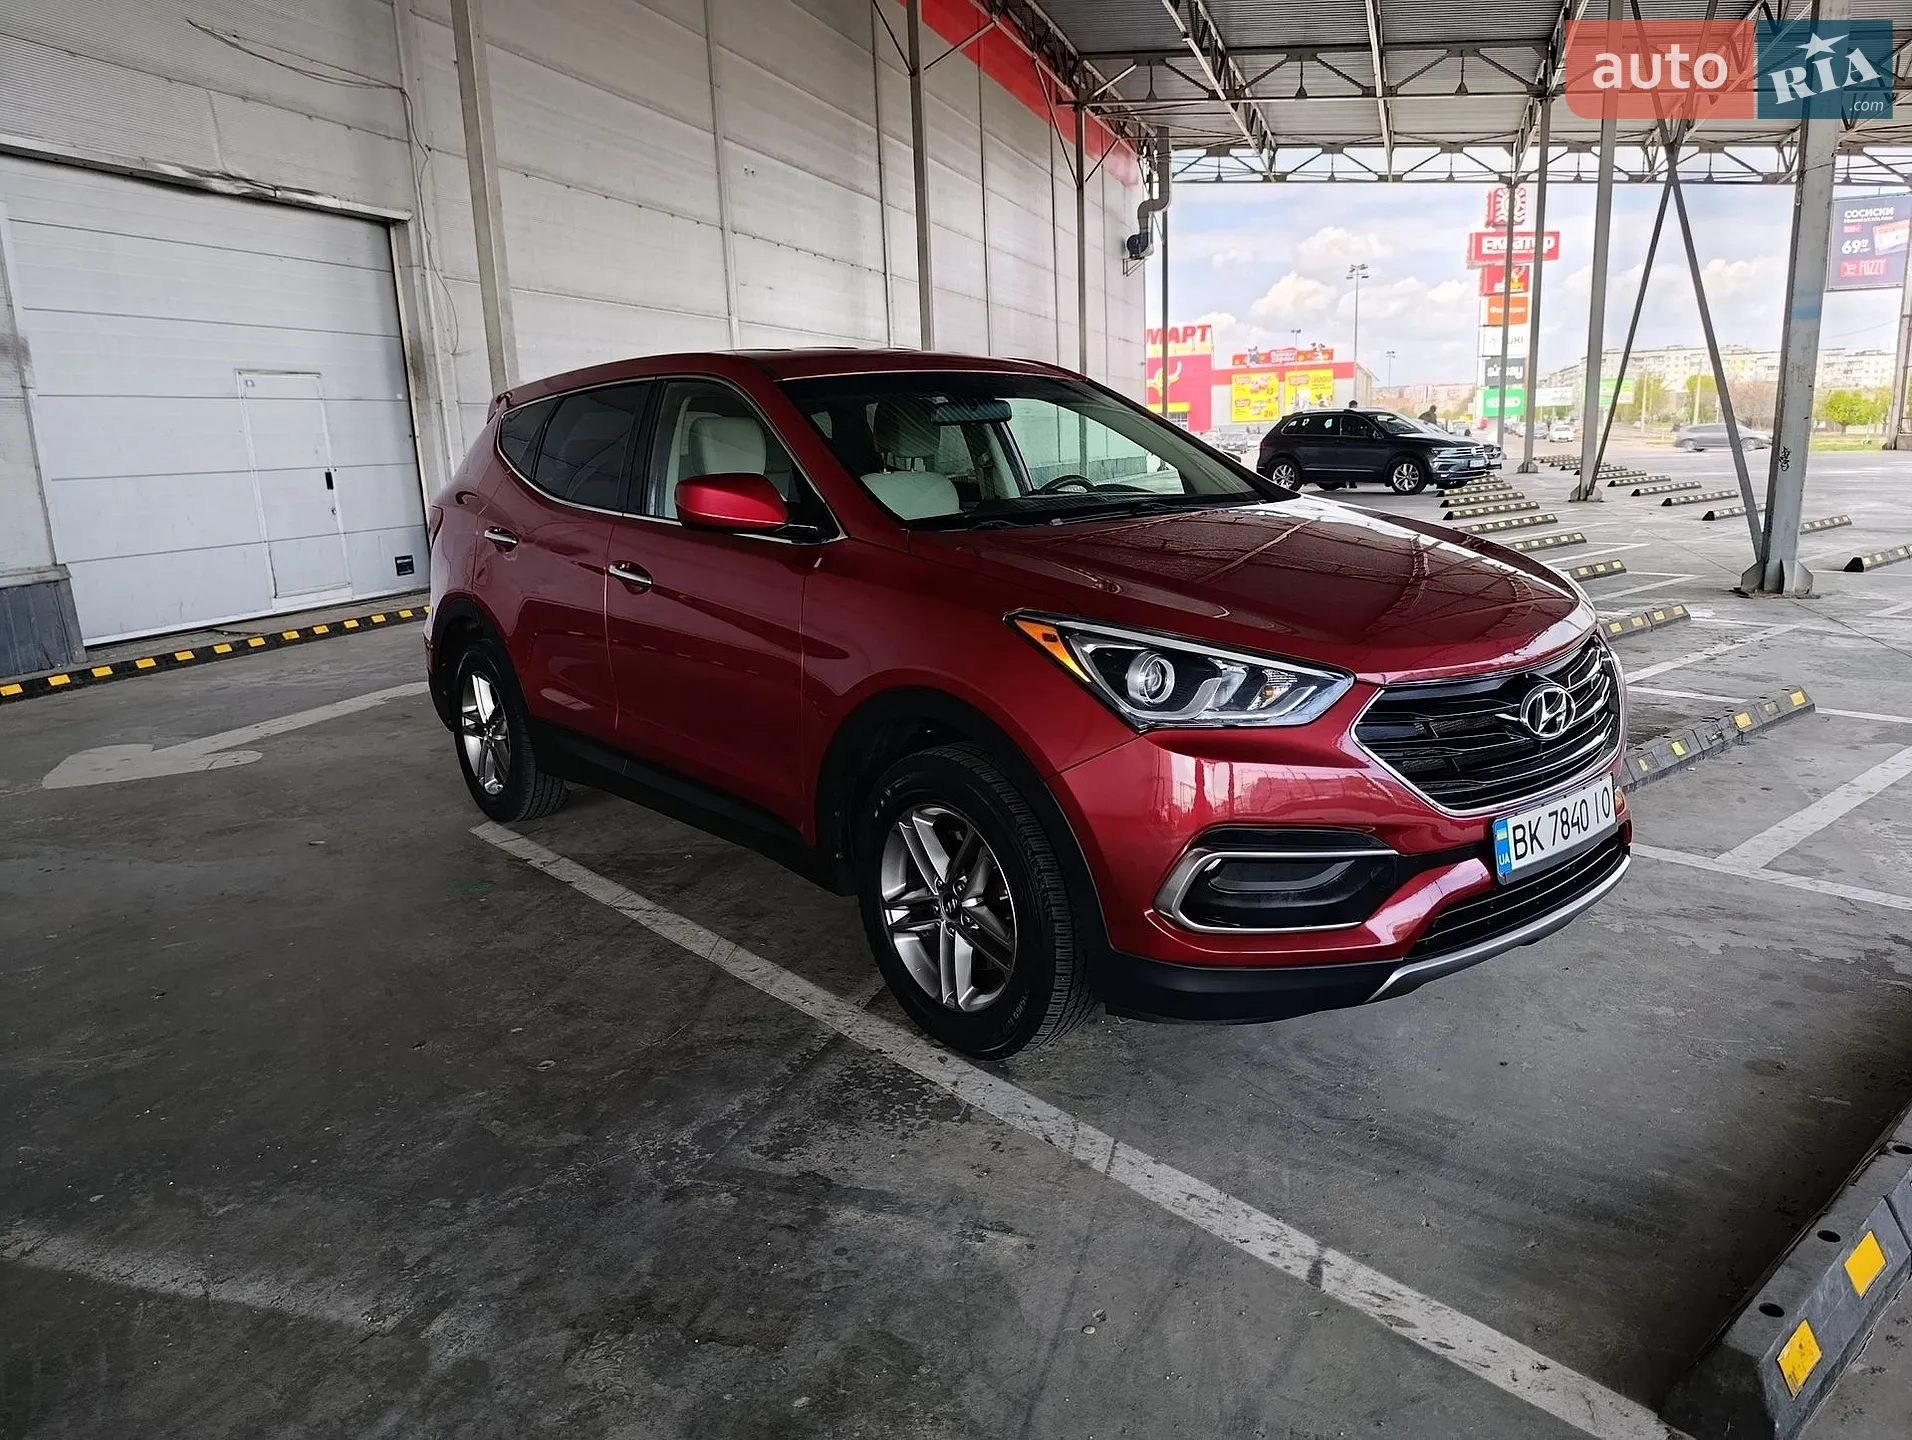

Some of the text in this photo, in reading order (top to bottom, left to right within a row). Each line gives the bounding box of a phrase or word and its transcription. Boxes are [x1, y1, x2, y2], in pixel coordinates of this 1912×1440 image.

[1844, 207, 1894, 219] СОСИСКИ
[1482, 236, 1555, 254] Екатр
[1512, 816, 1545, 861] BK
[1548, 798, 1590, 846] 7840
[1498, 854, 1511, 865] UA
